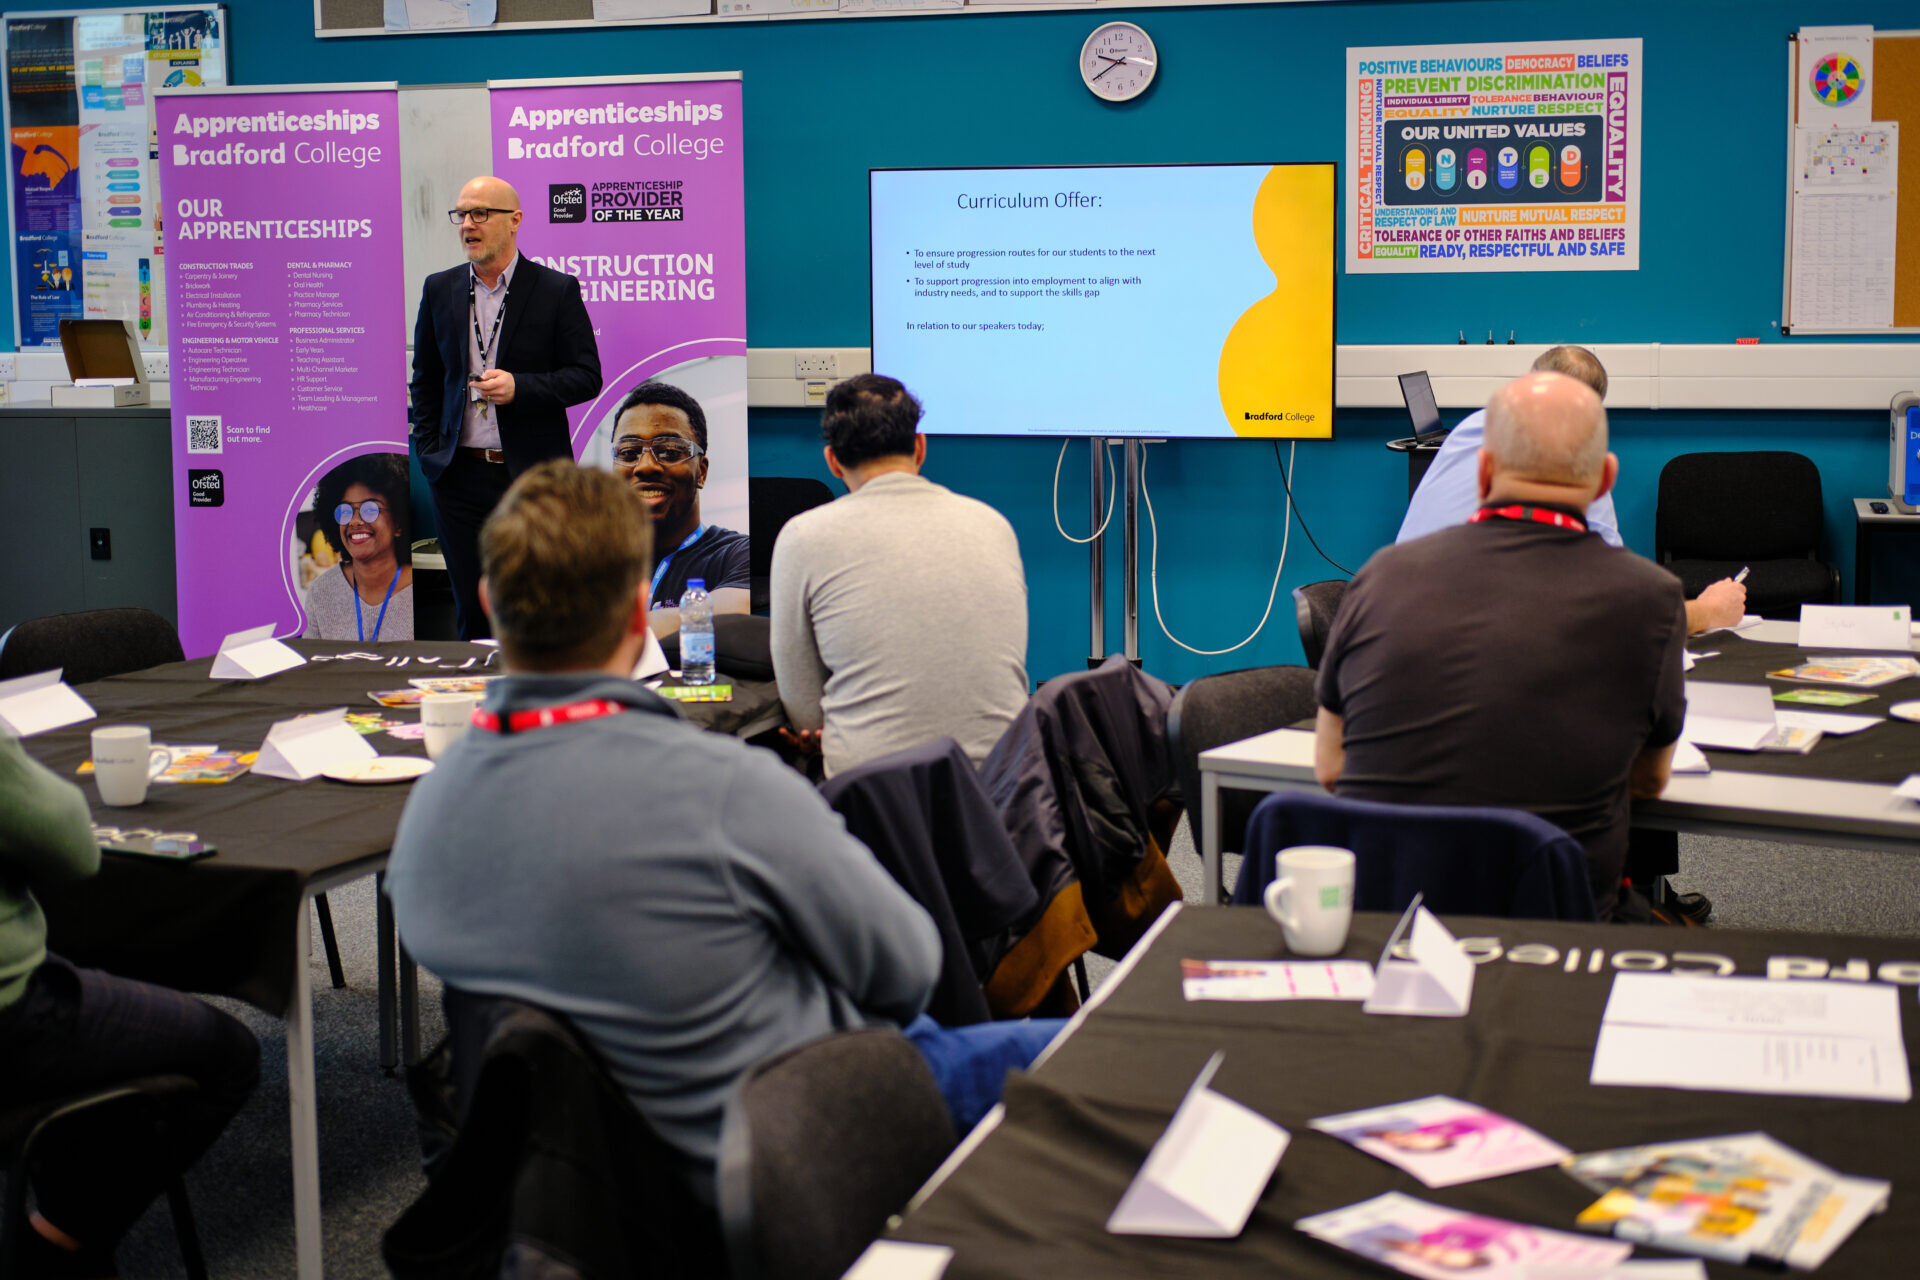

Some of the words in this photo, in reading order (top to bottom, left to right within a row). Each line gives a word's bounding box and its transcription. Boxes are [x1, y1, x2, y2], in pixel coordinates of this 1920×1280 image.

[1114, 33, 1123, 41] 12
[1358, 60, 1417, 75] POSITIVE
[1420, 57, 1503, 74] BEHAVIOURS
[1507, 57, 1573, 70] DEMOCRACY
[1577, 53, 1629, 68] BELIEFS
[1384, 76, 1461, 94] PREVENT
[1466, 72, 1605, 92] DISCRIMINATION
[1387, 97, 1432, 105] INDIVIDUAL
[1434, 96, 1468, 104] LIBERTY
[1471, 94, 1532, 103] TOLERANCE
[1533, 92, 1604, 102] BEHAVIOUR
[1384, 107, 1470, 118] EQUALITY
[1472, 104, 1535, 116] NURTURE
[1537, 102, 1604, 114] RESPECT
[508, 100, 723, 130] Apprenticeships
[173, 109, 380, 138] Apprenticeships
[1360, 82, 1373, 169] THINKING
[1401, 126, 1440, 140] OUR
[1443, 124, 1510, 139] UNITED
[1514, 122, 1586, 138] VALUES
[1608, 76, 1625, 197] EQUALITY
[508, 134, 624, 160] Bradford
[633, 133, 724, 160] College
[173, 142, 286, 166] Bradford
[294, 141, 382, 168] College
[1410, 177, 1420, 187] U
[1441, 154, 1451, 164] N
[1503, 153, 1513, 163] T
[1535, 174, 1544, 185] E
[1567, 150, 1577, 161] D
[591, 180, 683, 192] APPRENTICESHIP
[553, 193, 583, 205] Ofsted
[591, 191, 683, 207] PROVIDER
[957, 192, 1049, 209] Curriculum
[1054, 191, 1103, 208] Offer:
[177, 198, 223, 218] OUR
[1359, 172, 1372, 254] CRITICAL
[1374, 207, 1438, 216] UNDERSTANDING
[1439, 207, 1457, 215] AND
[594, 209, 613, 221] OF
[615, 209, 642, 221] THE
[645, 208, 681, 220] YEAR
[1462, 209, 1517, 222] NURTURE
[1520, 208, 1568, 222] MUTUAL
[1570, 207, 1623, 221] RESPECT
[1374, 216, 1417, 227] RESPECT
[1419, 216, 1430, 226] OF
[1434, 216, 1457, 226] LAW
[178, 219, 373, 240] APPRENTICESHIPS
[1374, 230, 1442, 242] TOLERANCE
[1445, 229, 1461, 241] OF
[1463, 229, 1502, 241] OTHER
[1505, 228, 1547, 241] FAITHS
[1549, 228, 1575, 241] AND
[1578, 228, 1626, 240] BELIEFS
[914, 249, 924, 257] To
[925, 249, 954, 257] ensure
[956, 249, 1006, 259] progression
[1008, 249, 1036, 257] routes
[1037, 248, 1049, 257] for
[1052, 249, 1066, 257] our
[1069, 248, 1106, 257] students
[1108, 248, 1118, 256] to
[1119, 247, 1134, 256] the
[1136, 248, 1156, 256] next
[1375, 247, 1417, 256] EQUALITY
[1419, 244, 1466, 260] READY,
[1469, 243, 1554, 257] RESPECTFUL
[1557, 242, 1587, 256] AND
[1590, 241, 1625, 256] SAFE
[179, 262, 229, 270] CONSTRUCTION
[229, 262, 254, 270] TRADES
[287, 261, 311, 269] DENTAL
[318, 261, 352, 269] PHARMACY
[914, 260, 934, 269] level
[935, 260, 945, 269] of
[946, 260, 970, 270] study
[914, 277, 925, 285] To
[926, 277, 959, 287] support
[961, 277, 1011, 287] progression
[1012, 276, 1029, 285] into
[1031, 276, 1086, 286] employment
[1088, 277, 1098, 285] to
[1099, 276, 1120, 286] align
[1121, 276, 1142, 285] with
[914, 288, 949, 298] industry
[950, 288, 979, 298] needs,
[980, 288, 997, 297] and
[999, 289, 1008, 297] to
[1009, 288, 1043, 298] support
[1045, 288, 1059, 297] the
[1061, 288, 1083, 297] skills
[1084, 289, 1100, 298] gap
[906, 322, 915, 330] In
[916, 322, 949, 330] relation
[951, 322, 960, 330] to
[978, 322, 1016, 332] speakers
[1017, 322, 1045, 332] today;
[1244, 412, 1283, 421] Bradford
[1285, 412, 1315, 423] College
[226, 425, 245, 434] Scan
[246, 426, 254, 434] to
[255, 425, 271, 434] find
[227, 435, 240, 443] out
[241, 435, 263, 443] more.
[192, 479, 220, 489] Ofsted
